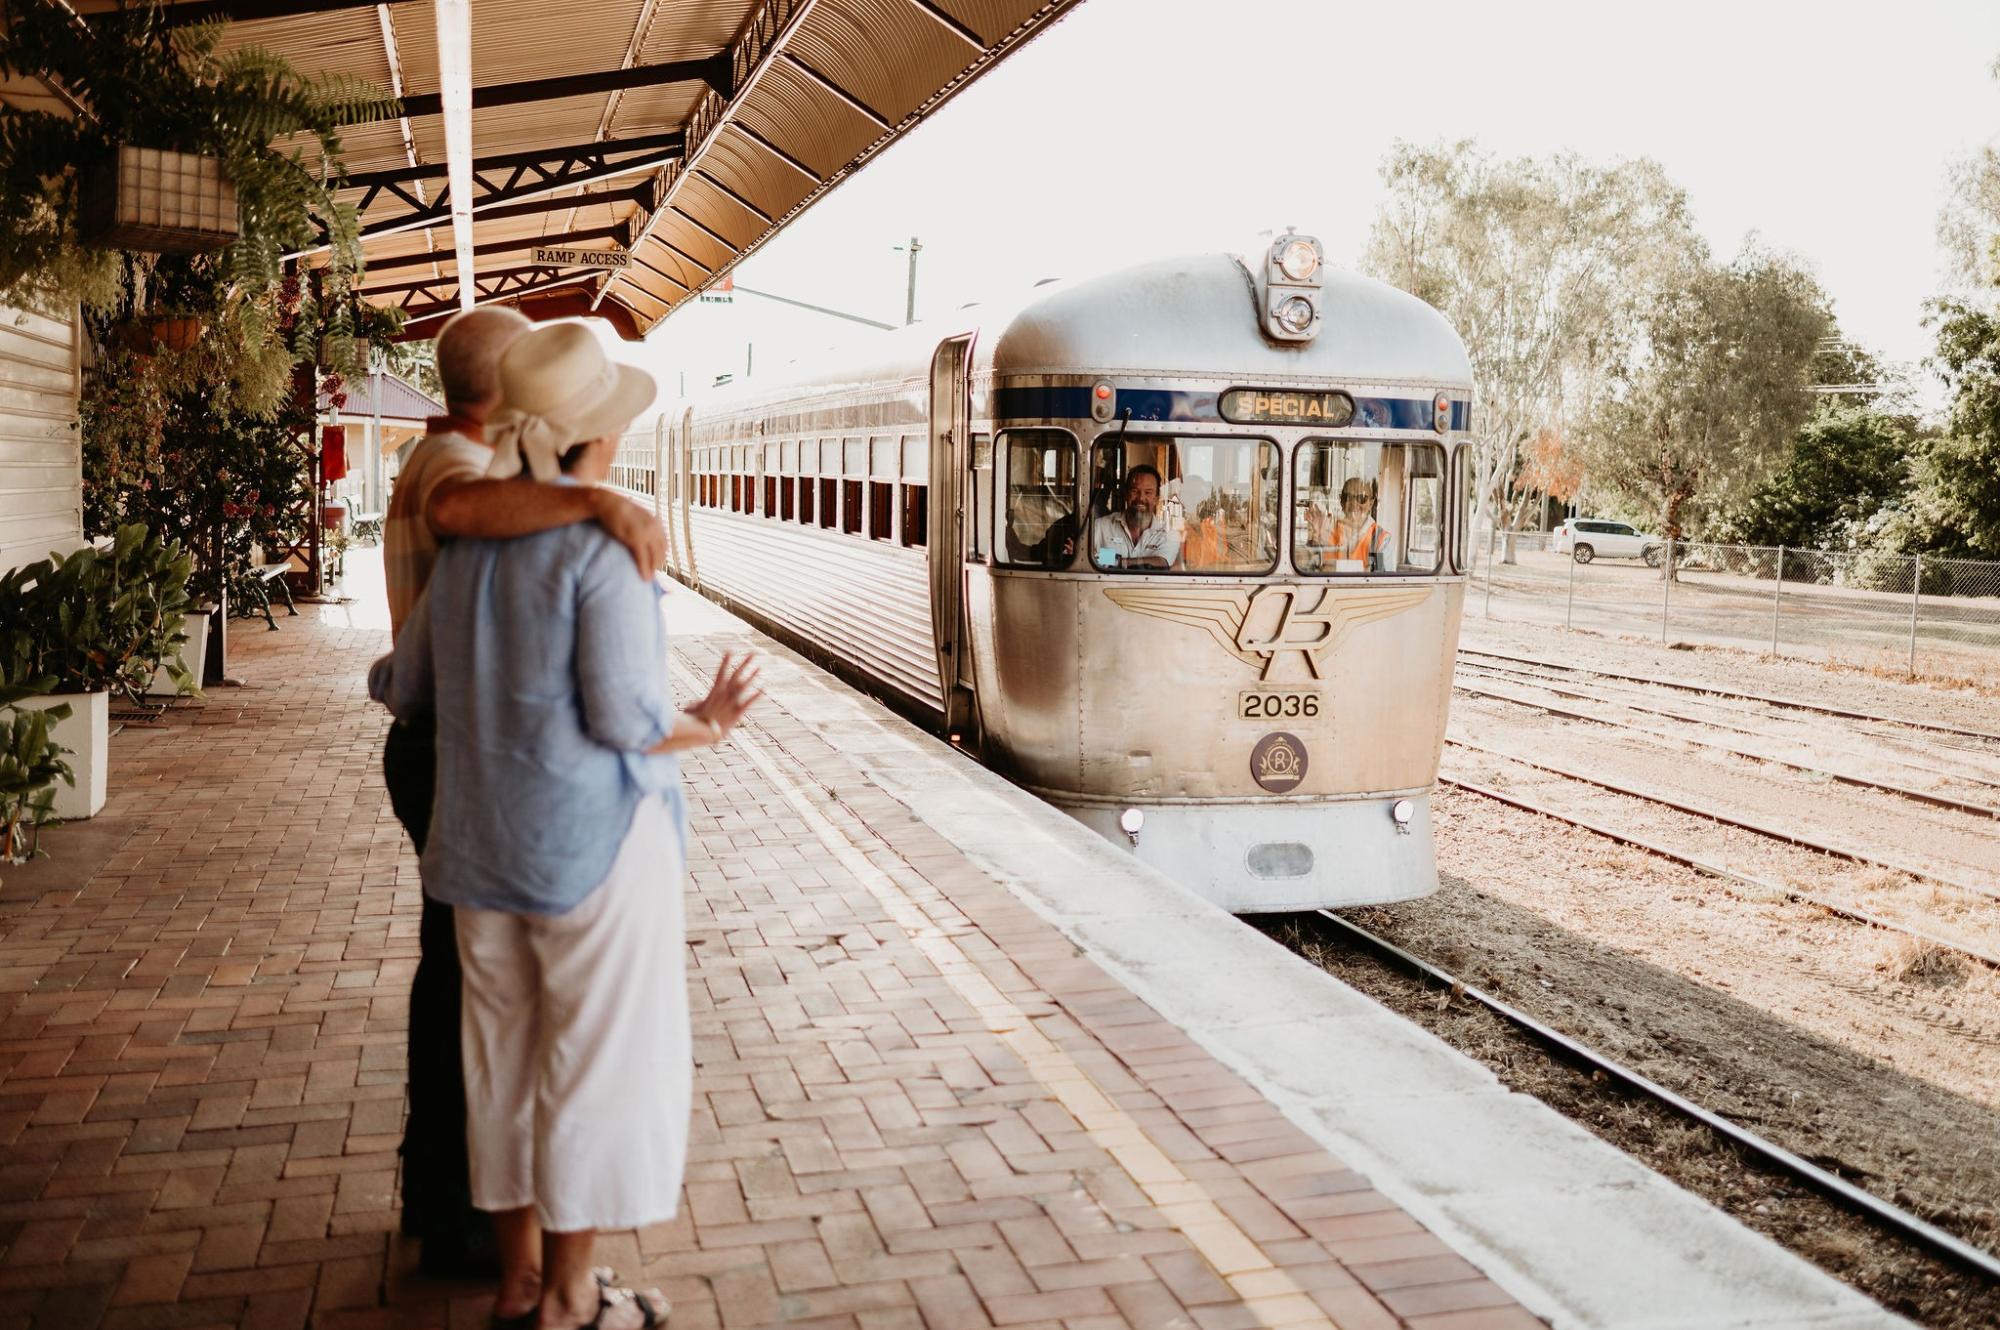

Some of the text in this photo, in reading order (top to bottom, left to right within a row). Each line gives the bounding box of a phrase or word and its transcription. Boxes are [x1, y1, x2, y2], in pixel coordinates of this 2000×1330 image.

[536, 249, 628, 266] RAMP ACCESS
[1238, 396, 1334, 418] SPECIAL
[1244, 694, 1320, 718] 2036
